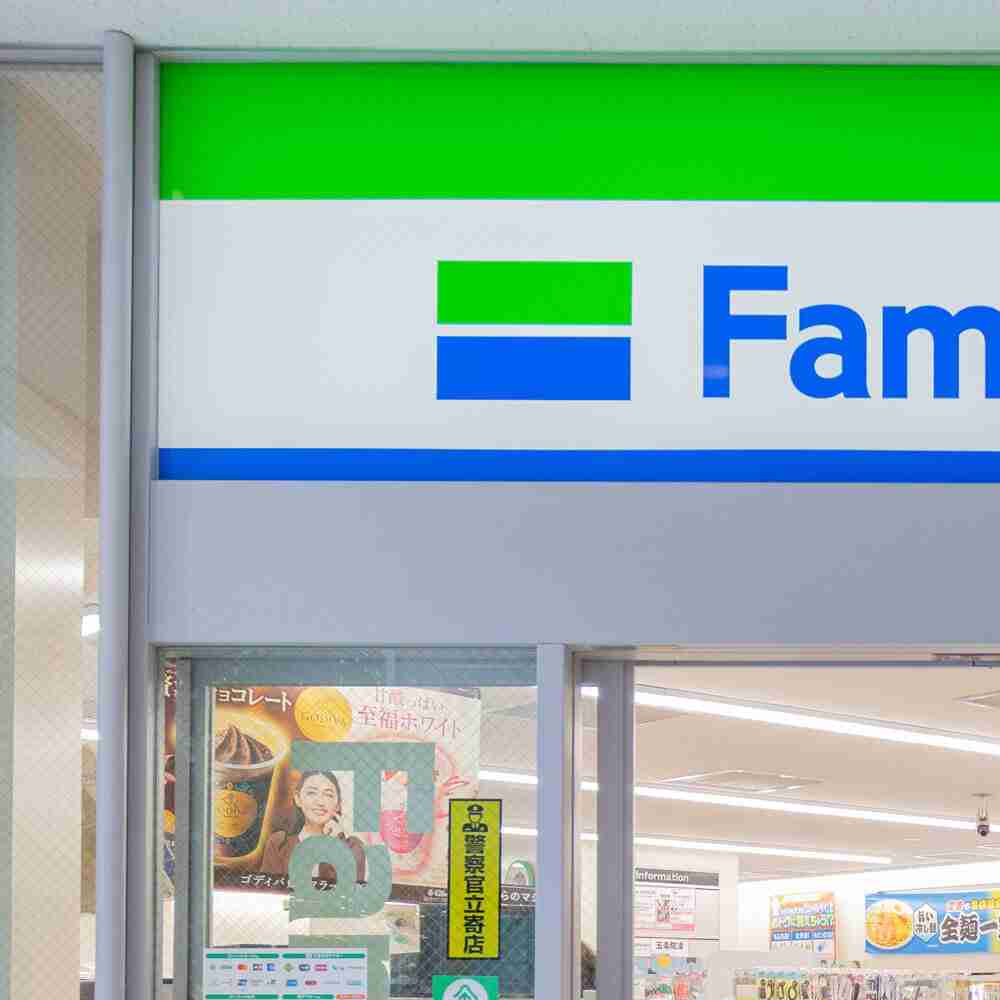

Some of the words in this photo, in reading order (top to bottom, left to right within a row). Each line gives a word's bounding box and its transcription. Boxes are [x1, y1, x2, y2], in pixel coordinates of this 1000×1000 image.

[463, 834, 485, 955] 警察官立寄店
